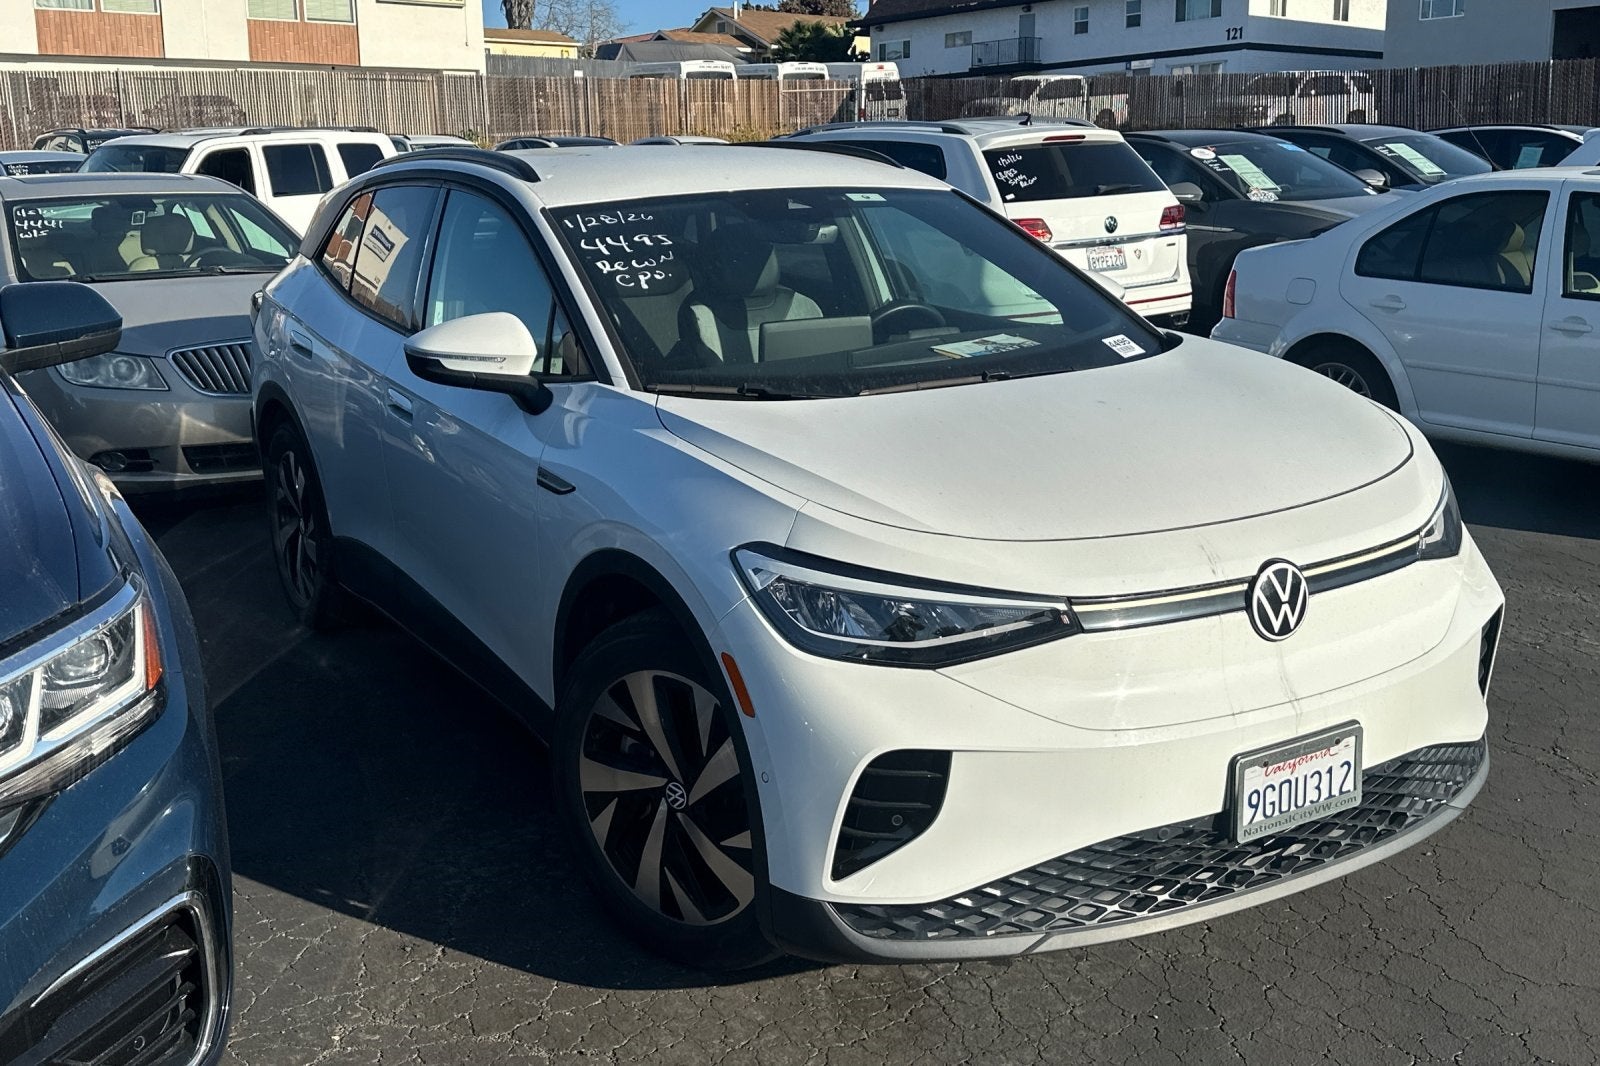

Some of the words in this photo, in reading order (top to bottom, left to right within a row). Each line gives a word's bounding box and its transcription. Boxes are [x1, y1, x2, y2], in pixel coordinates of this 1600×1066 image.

[1226, 26, 1243, 41] 121
[15, 220, 63, 229] 4441
[563, 210, 653, 233] 1/28/26
[580, 234, 673, 255] 4495
[1091, 254, 1125, 269] 8YPE120
[1253, 562, 1309, 640] VW
[1264, 747, 1339, 777] California
[1243, 795, 1358, 838] NationalCityVW.com
